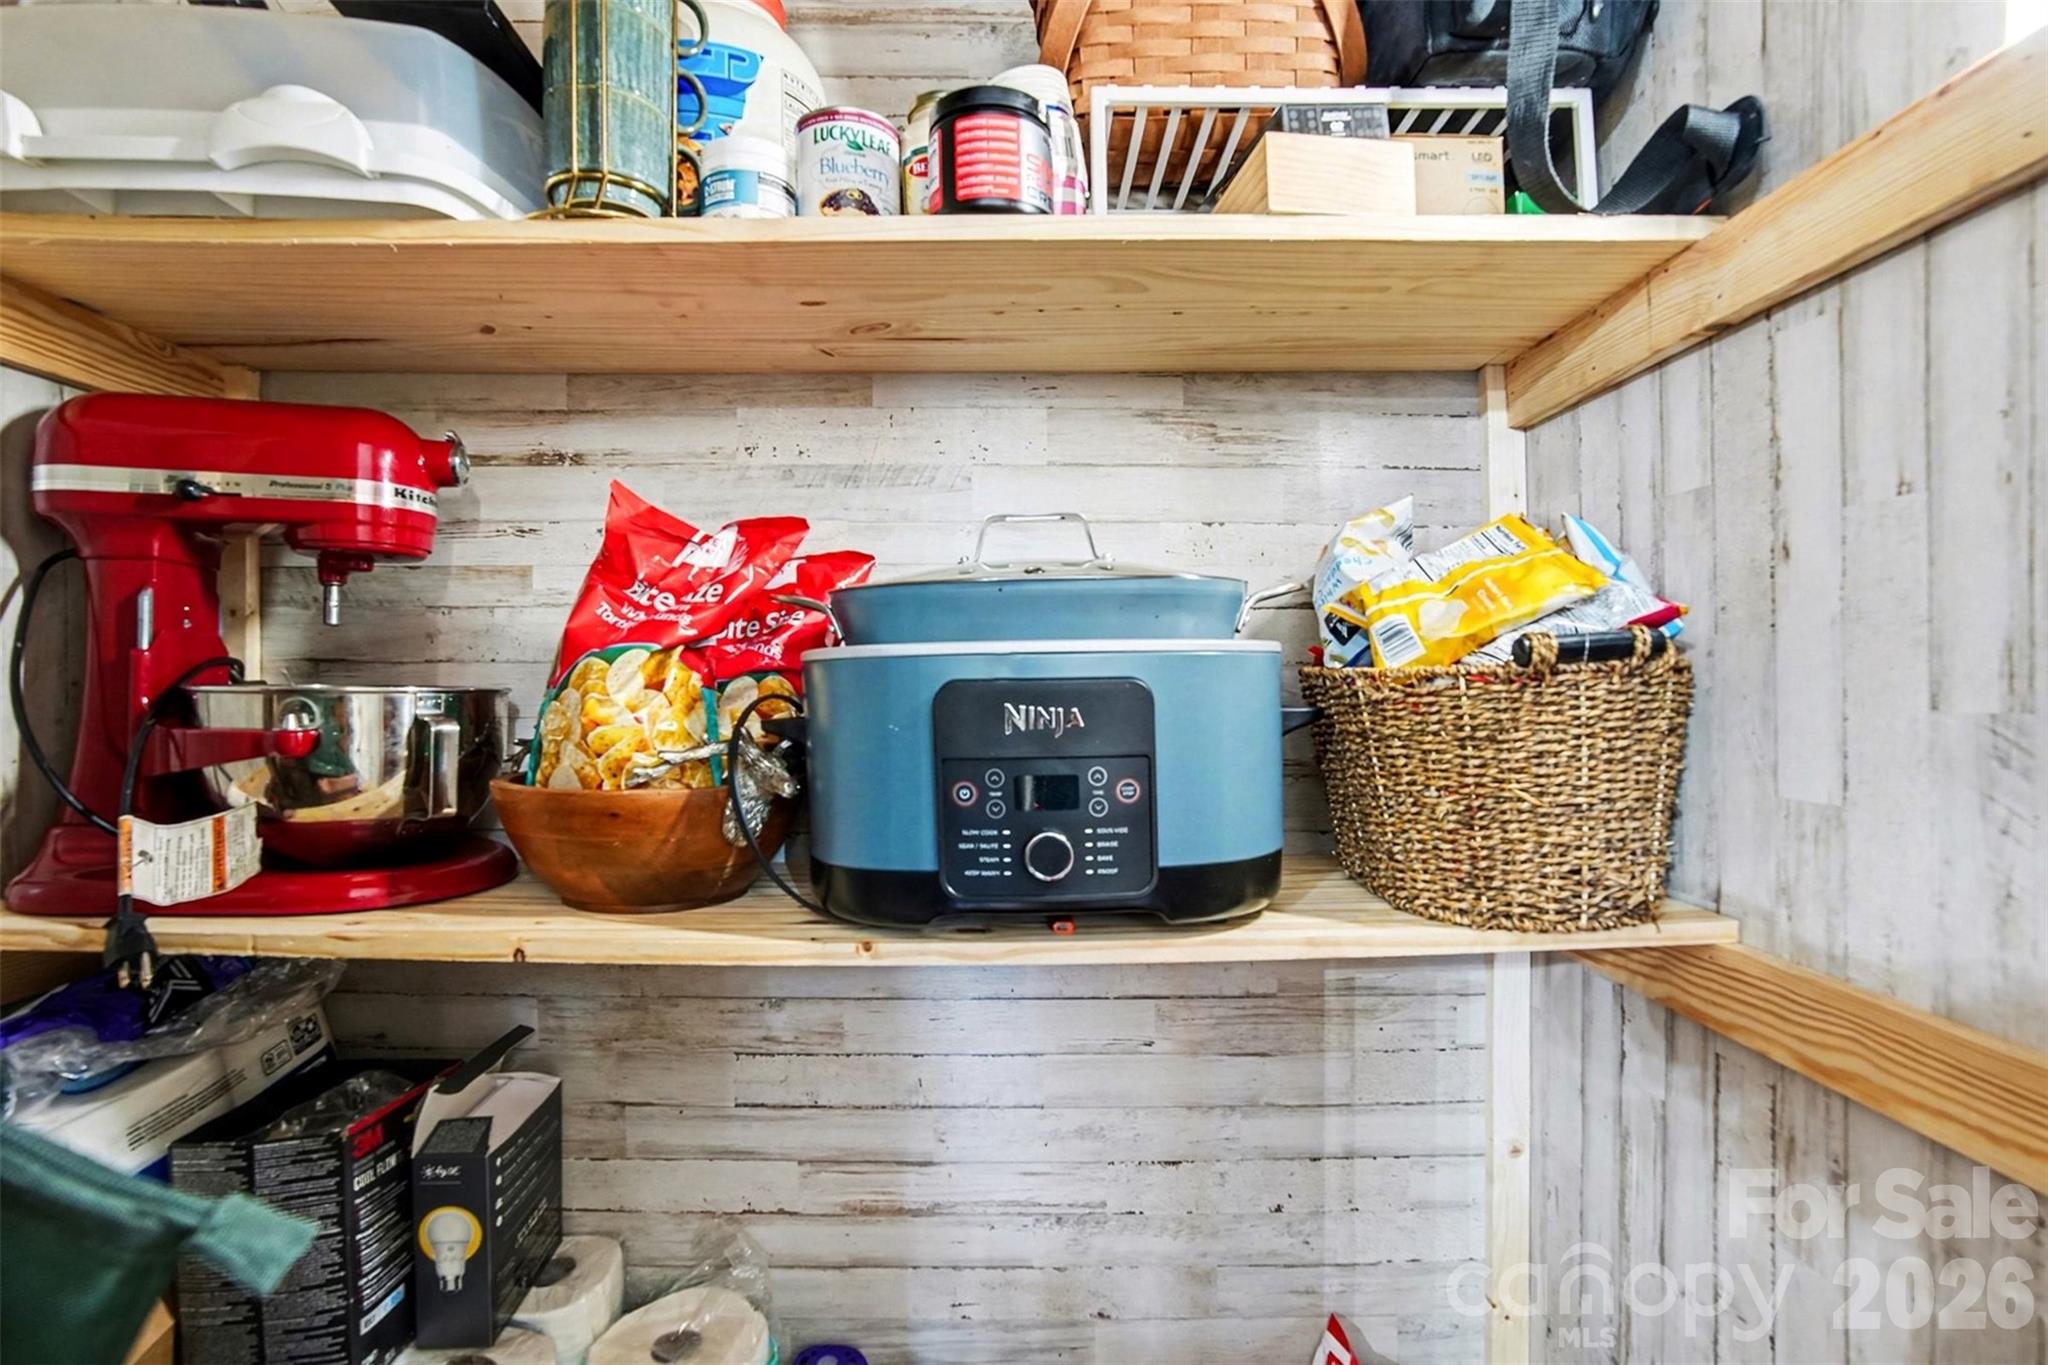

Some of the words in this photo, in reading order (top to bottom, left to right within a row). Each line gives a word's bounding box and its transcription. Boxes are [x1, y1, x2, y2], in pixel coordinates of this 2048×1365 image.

[813, 125, 861, 145] LUCKY
[819, 156, 890, 187] Blueberry
[1003, 702, 1086, 739] NINJA
